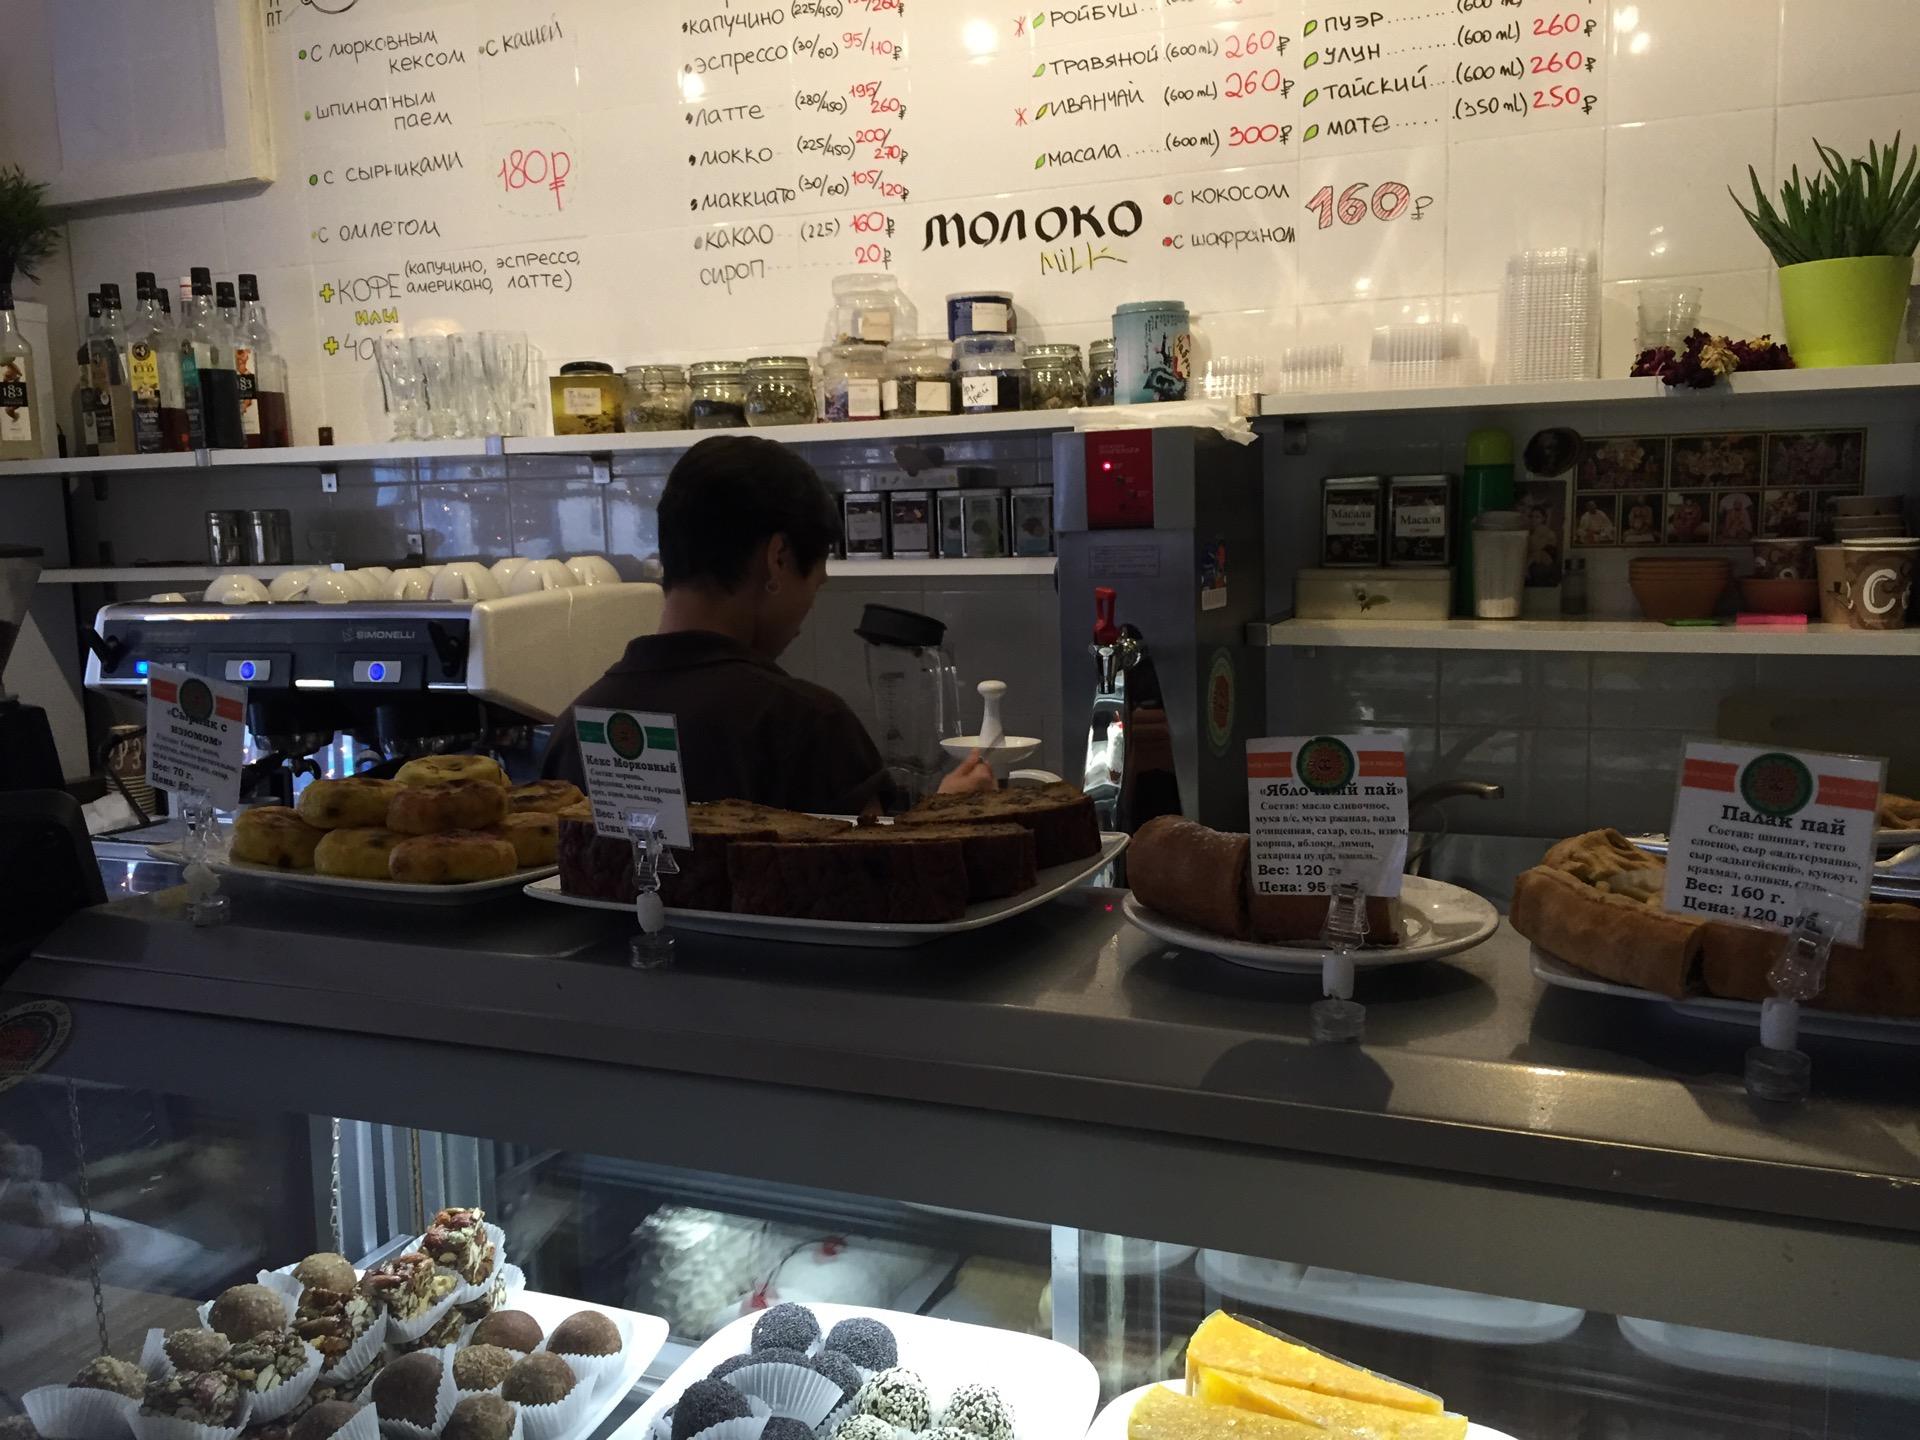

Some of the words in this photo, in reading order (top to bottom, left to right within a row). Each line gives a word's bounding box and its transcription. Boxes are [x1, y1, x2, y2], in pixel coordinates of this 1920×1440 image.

[689, 9, 785, 37] капучино
[1050, 1, 1138, 28] РОЙБУШ
[1325, 12, 1384, 33] ПУЭР
[502, 13, 563, 53] кашей
[329, 30, 438, 63] морковным
[694, 45, 788, 75] эспрессо
[792, 34, 840, 59] (30/60)
[1323, 43, 1381, 65] УЛУН
[389, 50, 466, 74] кексом
[1323, 65, 1428, 99] тайский
[315, 90, 436, 121] шпинатным
[695, 104, 765, 127] латте
[795, 90, 848, 115] (280/450)
[1050, 79, 1144, 116] ИВАНЧАЙ
[394, 111, 453, 130] паем
[1327, 115, 1390, 137] мате
[700, 147, 773, 167] мокко
[797, 134, 856, 160] (225/450)
[1049, 142, 1121, 167] масала
[345, 151, 464, 183] сырниками
[701, 187, 796, 211] маккиато
[798, 174, 850, 197] (30/60)
[1191, 183, 1290, 204] кокосом
[339, 218, 440, 241] омлетом
[705, 223, 774, 251] какао
[800, 218, 841, 242] (225)
[922, 199, 1143, 252] МОЛОКО
[1191, 226, 1296, 250] шафраном
[405, 259, 487, 278] (капучино,
[497, 251, 581, 269] эспрессо,
[700, 259, 765, 295] сироп
[339, 273, 402, 305] КОФЕ
[406, 276, 494, 295] американо,
[508, 272, 573, 292] латте)
[355, 307, 398, 326] или
[1331, 509, 1371, 520] Масала
[1400, 514, 1440, 526] Масала
[356, 631, 415, 640] SIMONELLI
[171, 725, 222, 746] изюмом»
[585, 755, 611, 766] Кекс
[614, 759, 677, 773] Морковный
[1364, 782, 1404, 796] пай»
[1721, 805, 1792, 828] Палак
[1800, 818, 1846, 836] пай
[1708, 824, 1754, 841] Состав:
[1813, 840, 1846, 853] тесто
[1743, 845, 1766, 857] сыр
[1257, 864, 1290, 876] Вес:
[1296, 864, 1323, 876] 120
[1689, 851, 1712, 864] сыр
[1258, 881, 1302, 894] Цена:
[1307, 881, 1326, 893] 95
[1685, 877, 1723, 895] Вес:
[1731, 884, 1764, 901] 160
[1771, 893, 1785, 905] г.
[1682, 896, 1735, 917] Цена:
[1743, 905, 1776, 922] 120
